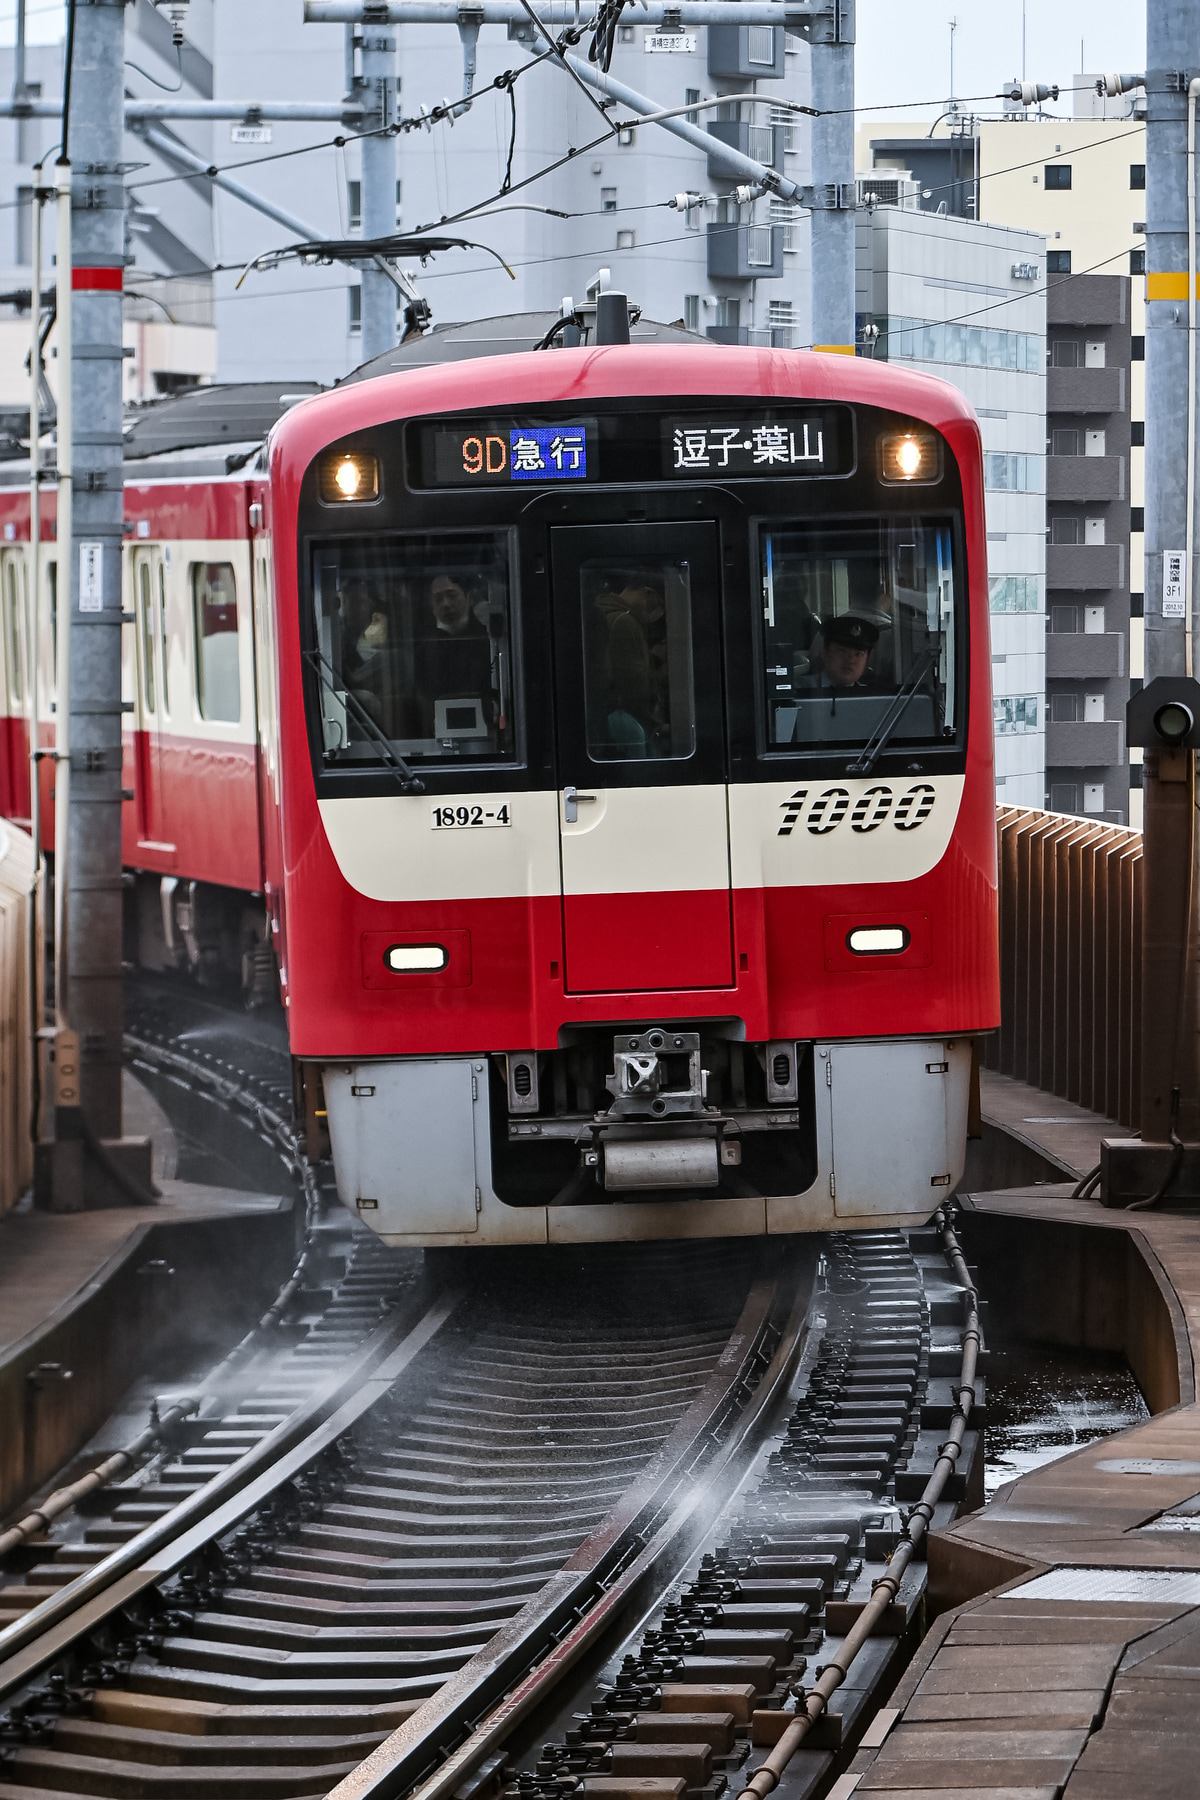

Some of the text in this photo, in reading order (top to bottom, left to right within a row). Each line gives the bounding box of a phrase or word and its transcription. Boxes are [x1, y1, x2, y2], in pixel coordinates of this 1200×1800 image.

[462, 436, 506, 473] 9D
[512, 435, 584, 471] 急行
[673, 424, 824, 468] 逗子・葉山
[432, 804, 510, 827] 1892-4
[777, 784, 936, 836] 1000
